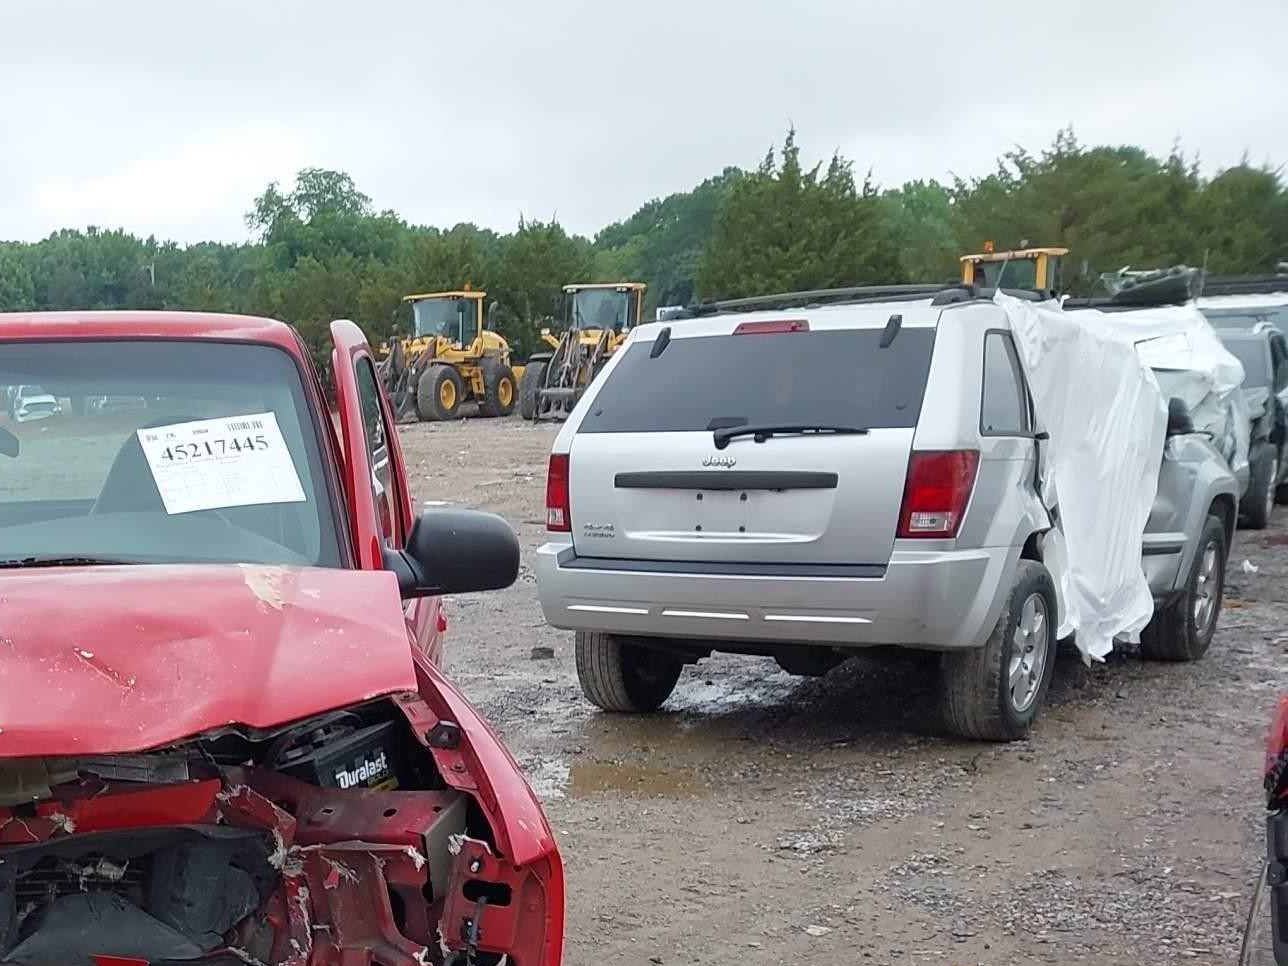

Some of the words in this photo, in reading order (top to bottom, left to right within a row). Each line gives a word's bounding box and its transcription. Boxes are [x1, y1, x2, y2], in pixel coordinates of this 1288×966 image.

[161, 435, 269, 461] 45217445
[702, 454, 737, 469] Jeep
[335, 752, 388, 789] Duralast
